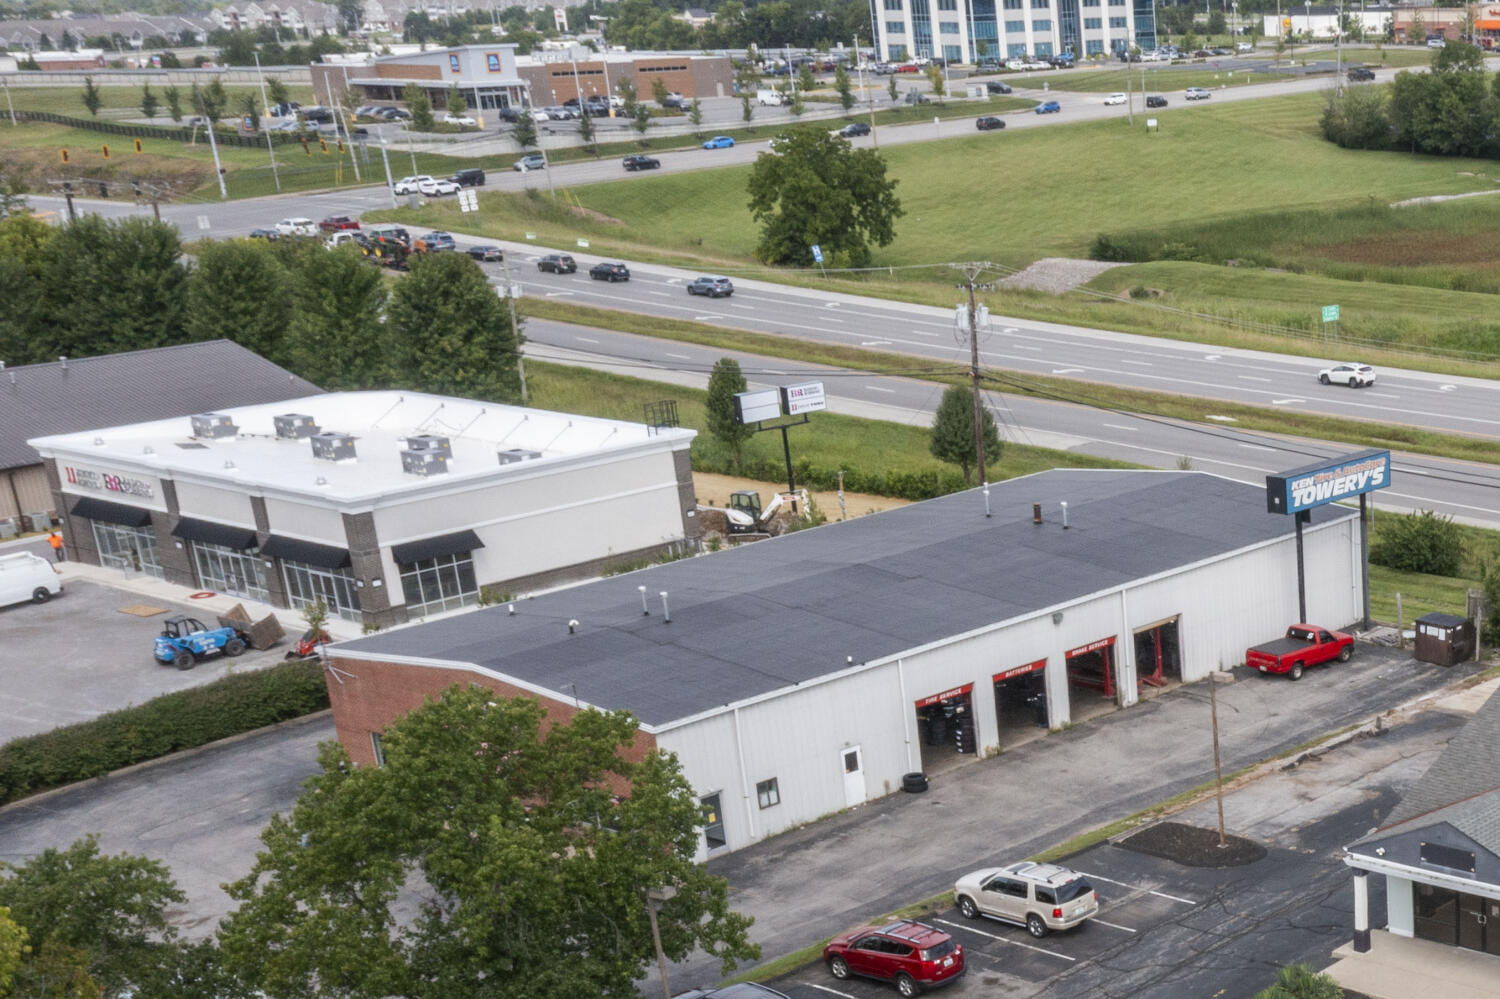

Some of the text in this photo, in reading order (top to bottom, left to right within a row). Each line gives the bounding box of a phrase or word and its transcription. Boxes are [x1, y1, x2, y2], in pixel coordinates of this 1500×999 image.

[1291, 476, 1314, 491] KEN
[1292, 466, 1385, 508] TOWERY'S
[1088, 639, 1109, 651] SERVICE
[1005, 664, 1033, 678] BATTERIES
[939, 687, 962, 701] SERVICE
